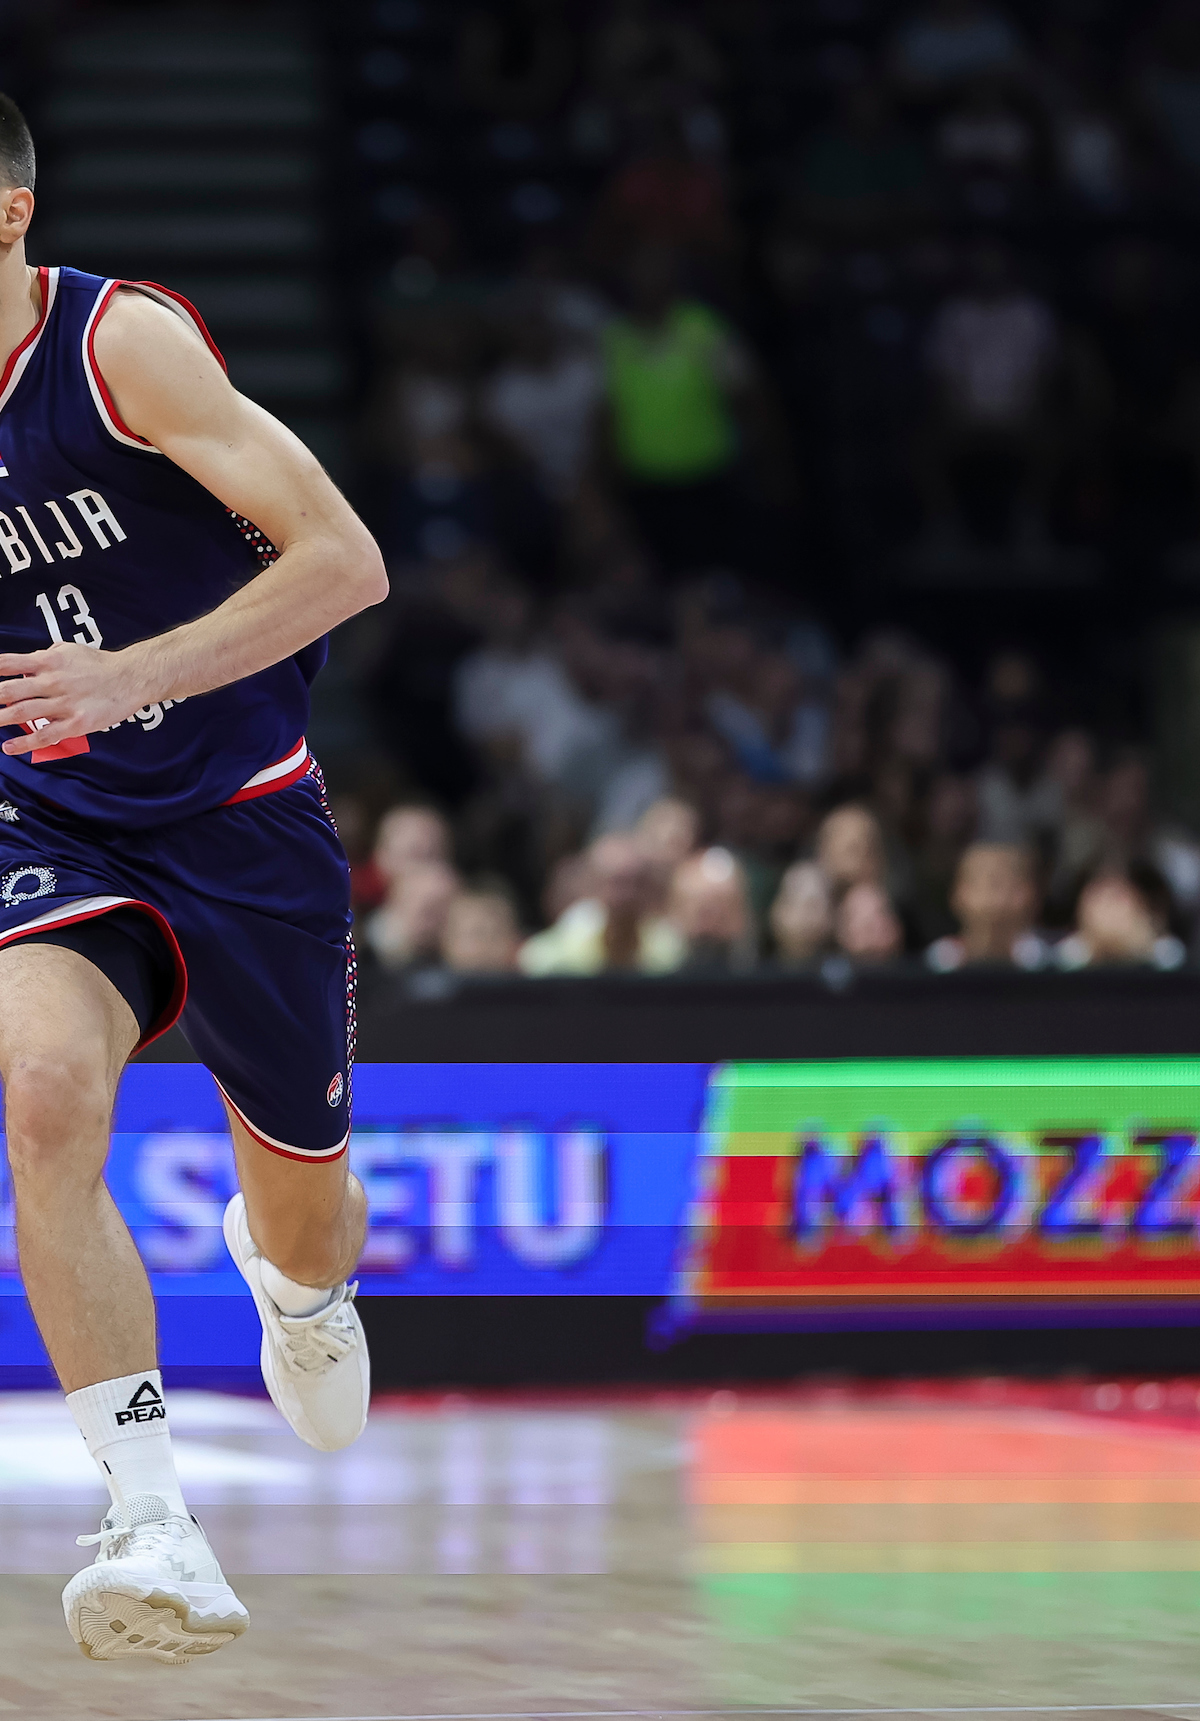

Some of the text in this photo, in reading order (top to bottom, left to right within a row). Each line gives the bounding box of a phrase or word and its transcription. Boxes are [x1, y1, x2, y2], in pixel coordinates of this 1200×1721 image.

[35, 584, 103, 649] 13
[134, 1130, 610, 1272] SETU
[792, 1124, 1200, 1244] MOZZ
